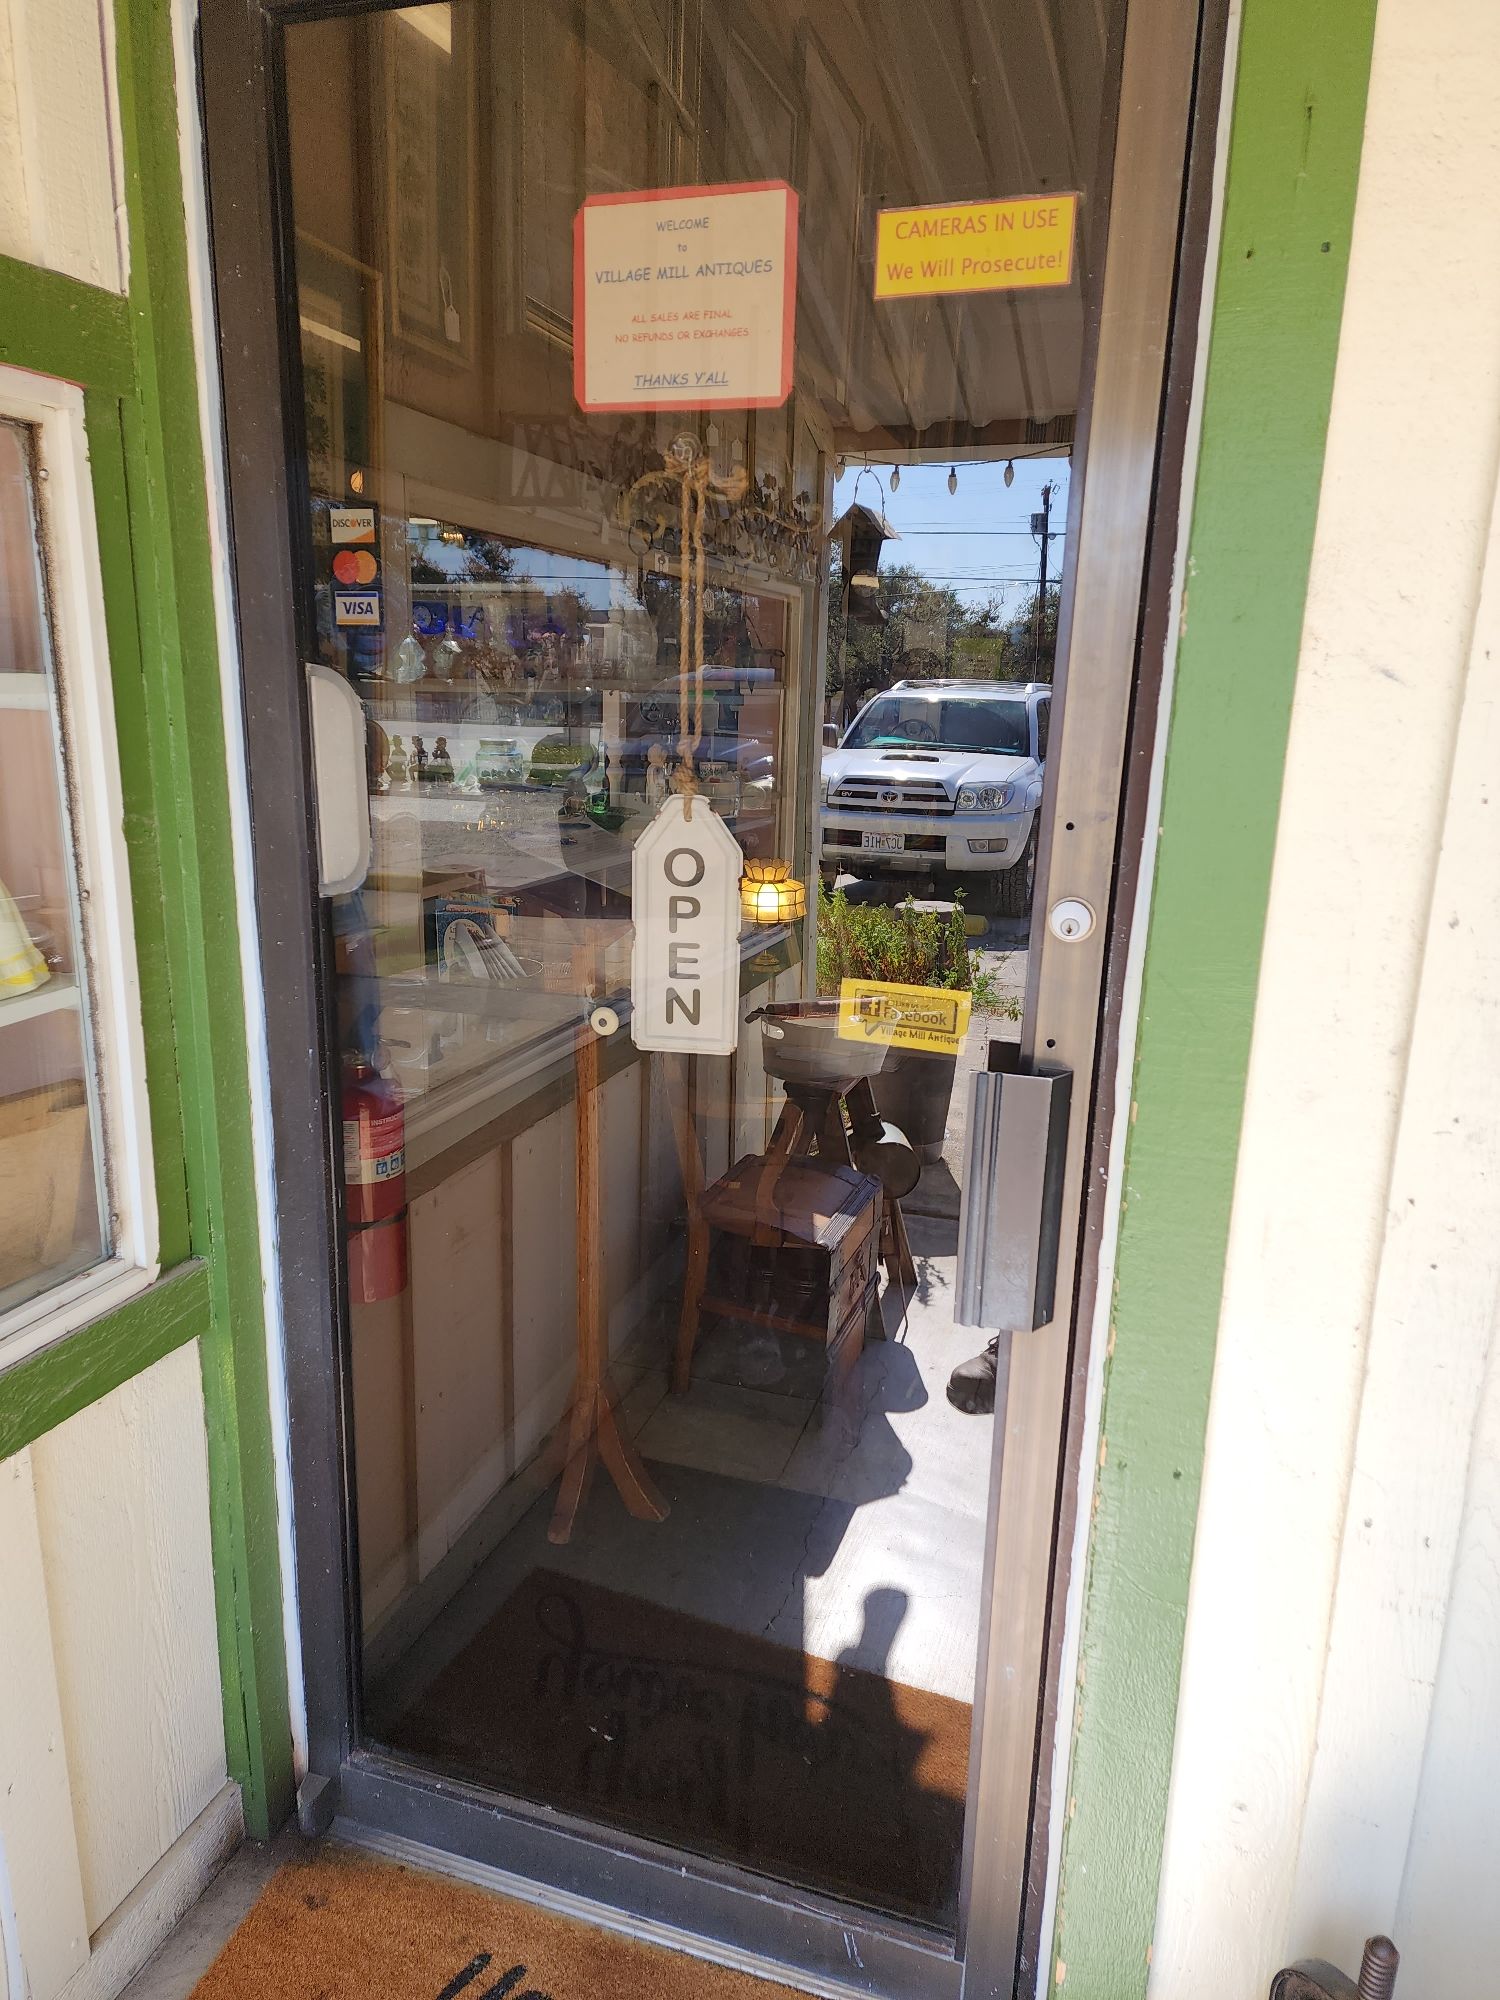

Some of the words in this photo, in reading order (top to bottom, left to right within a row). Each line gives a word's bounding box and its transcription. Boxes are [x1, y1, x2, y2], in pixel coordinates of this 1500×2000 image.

[656, 217, 710, 232] WELCOME
[895, 214, 987, 240] CAMERAS
[994, 212, 1015, 231] IN
[1023, 208, 1060, 229] USE
[677, 243, 688, 252] to
[595, 267, 651, 284] VILLAGE
[656, 265, 689, 280] MILL
[695, 259, 774, 277] ANTIQUES
[886, 263, 913, 281] We
[920, 258, 954, 278] Will
[961, 250, 1063, 276] Prosecute!
[631, 314, 646, 323] ALL
[650, 312, 679, 322] SALES
[682, 311, 701, 321] ARE
[703, 309, 733, 320] FINAL
[615, 334, 629, 343] NO
[632, 331, 674, 342] REFUNDS
[677, 330, 690, 340] OR
[693, 327, 750, 340] EXCHANGES
[634, 373, 689, 388] THANKS
[694, 371, 729, 386] Y'ALL
[332, 518, 372, 528] DISCOVER
[342, 601, 374, 615] VISA
[663, 847, 705, 1026] OPEN
[883, 1006, 947, 1026] Facebook
[880, 1025, 907, 1038] Village
[909, 1028, 926, 1040] Mill
[928, 1031, 963, 1046] Antique
